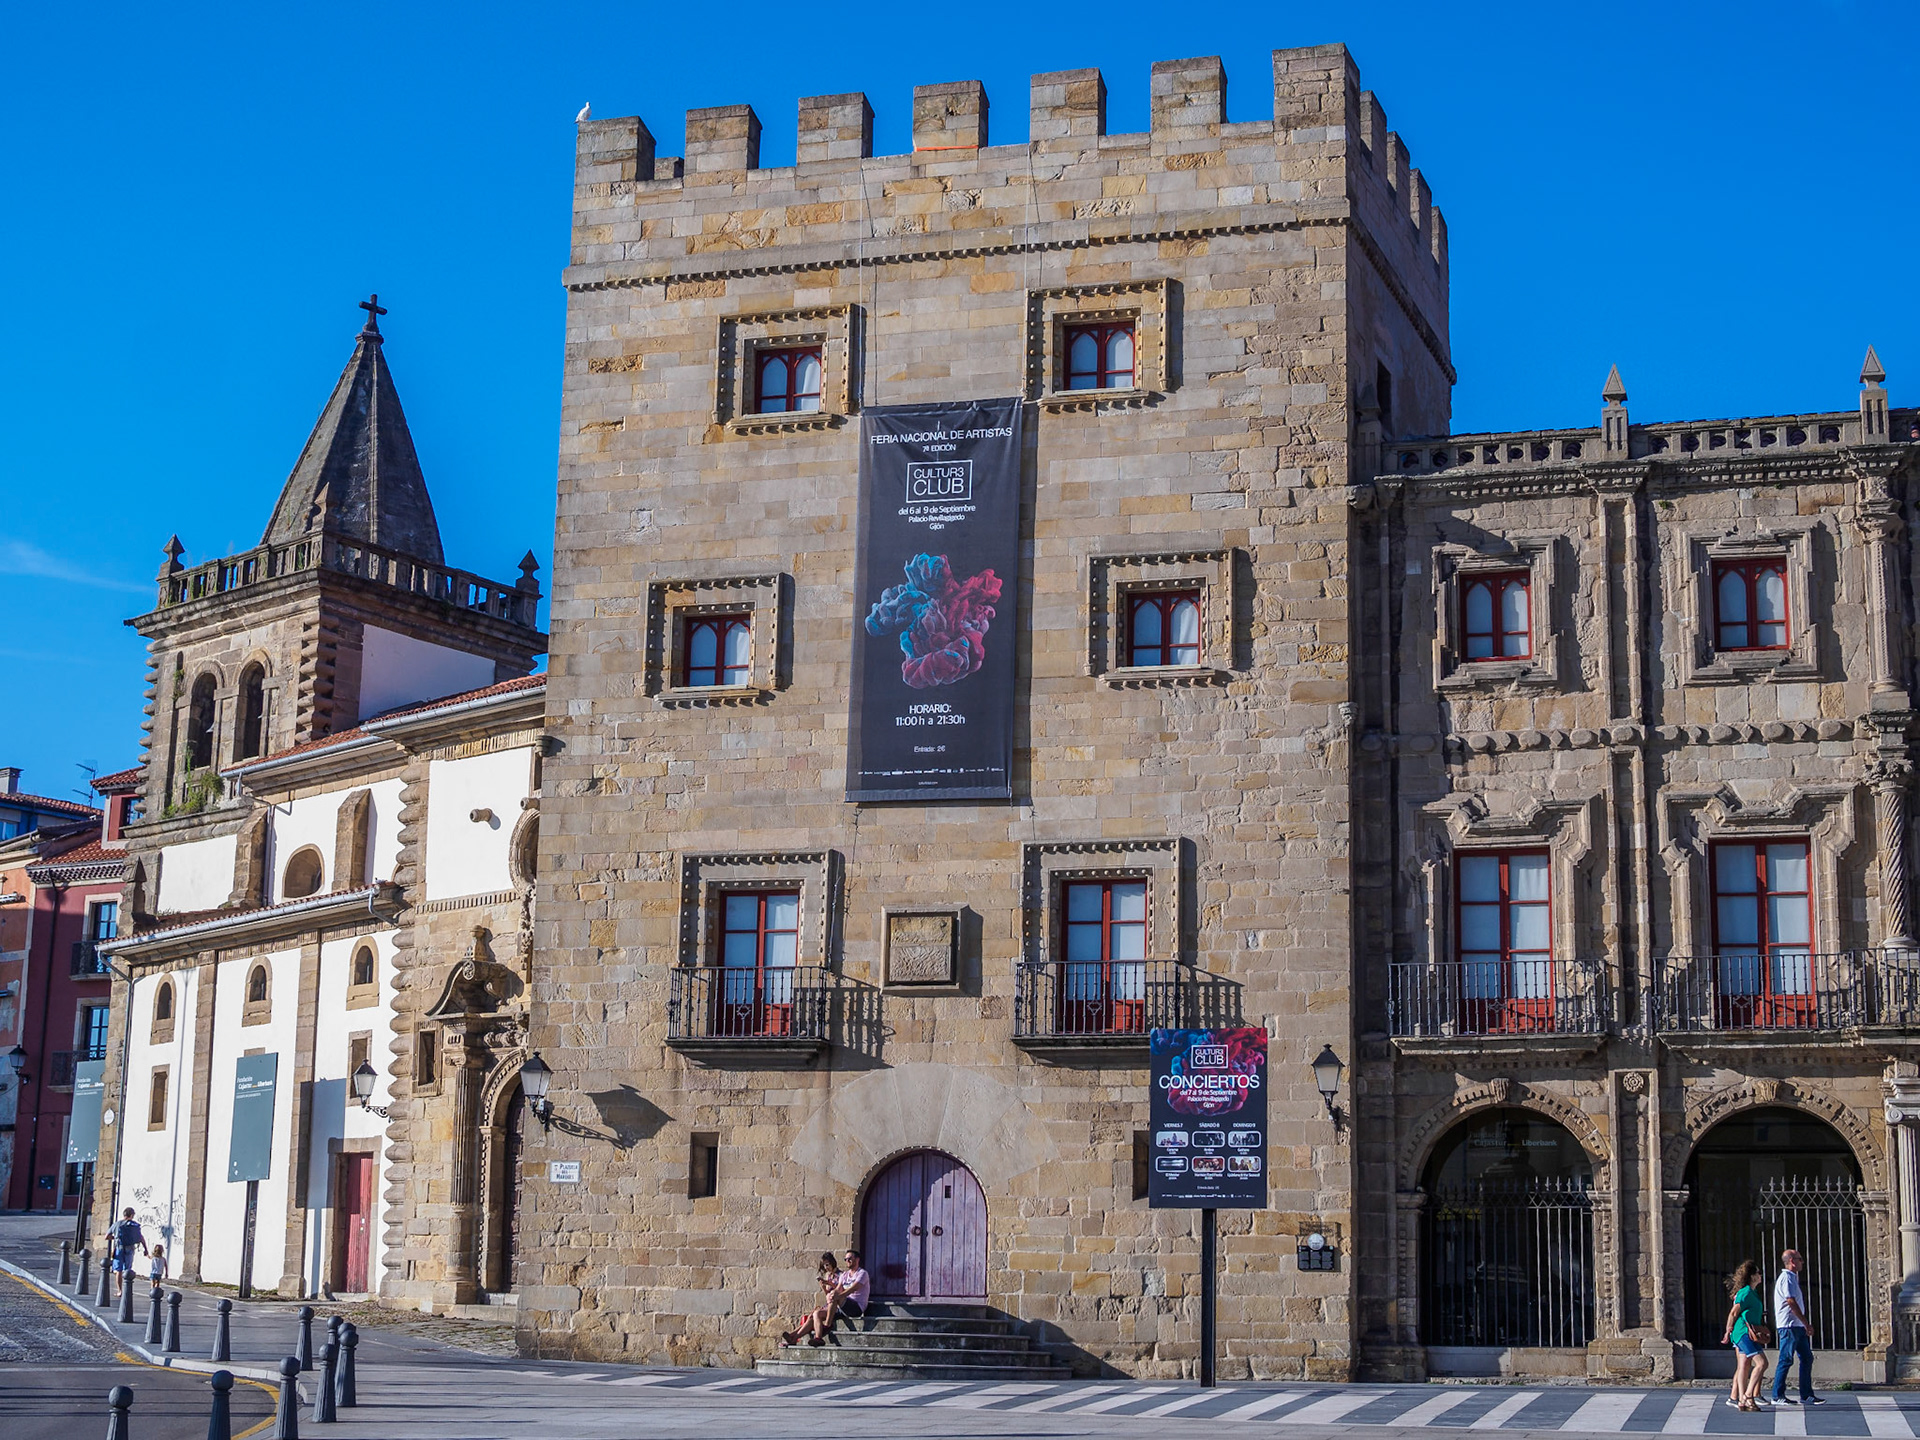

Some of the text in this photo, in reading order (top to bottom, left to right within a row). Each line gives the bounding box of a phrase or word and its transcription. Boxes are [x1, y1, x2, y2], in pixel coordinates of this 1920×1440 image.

[870, 427, 1013, 445] FERIA NACIONAL DE ARTISTAS
[931, 442, 957, 452] EDICIÓN
[913, 467, 964, 479] CULTUR3
[913, 478, 964, 496] CLUB
[898, 504, 977, 516] del 6 al 9 de Septiembre
[929, 522, 945, 531] Gijón
[909, 703, 952, 714] HORARIO:
[927, 717, 934, 726] a
[1194, 1055, 1224, 1065] CLUB
[1158, 1074, 1260, 1090] CONCIERTOS
